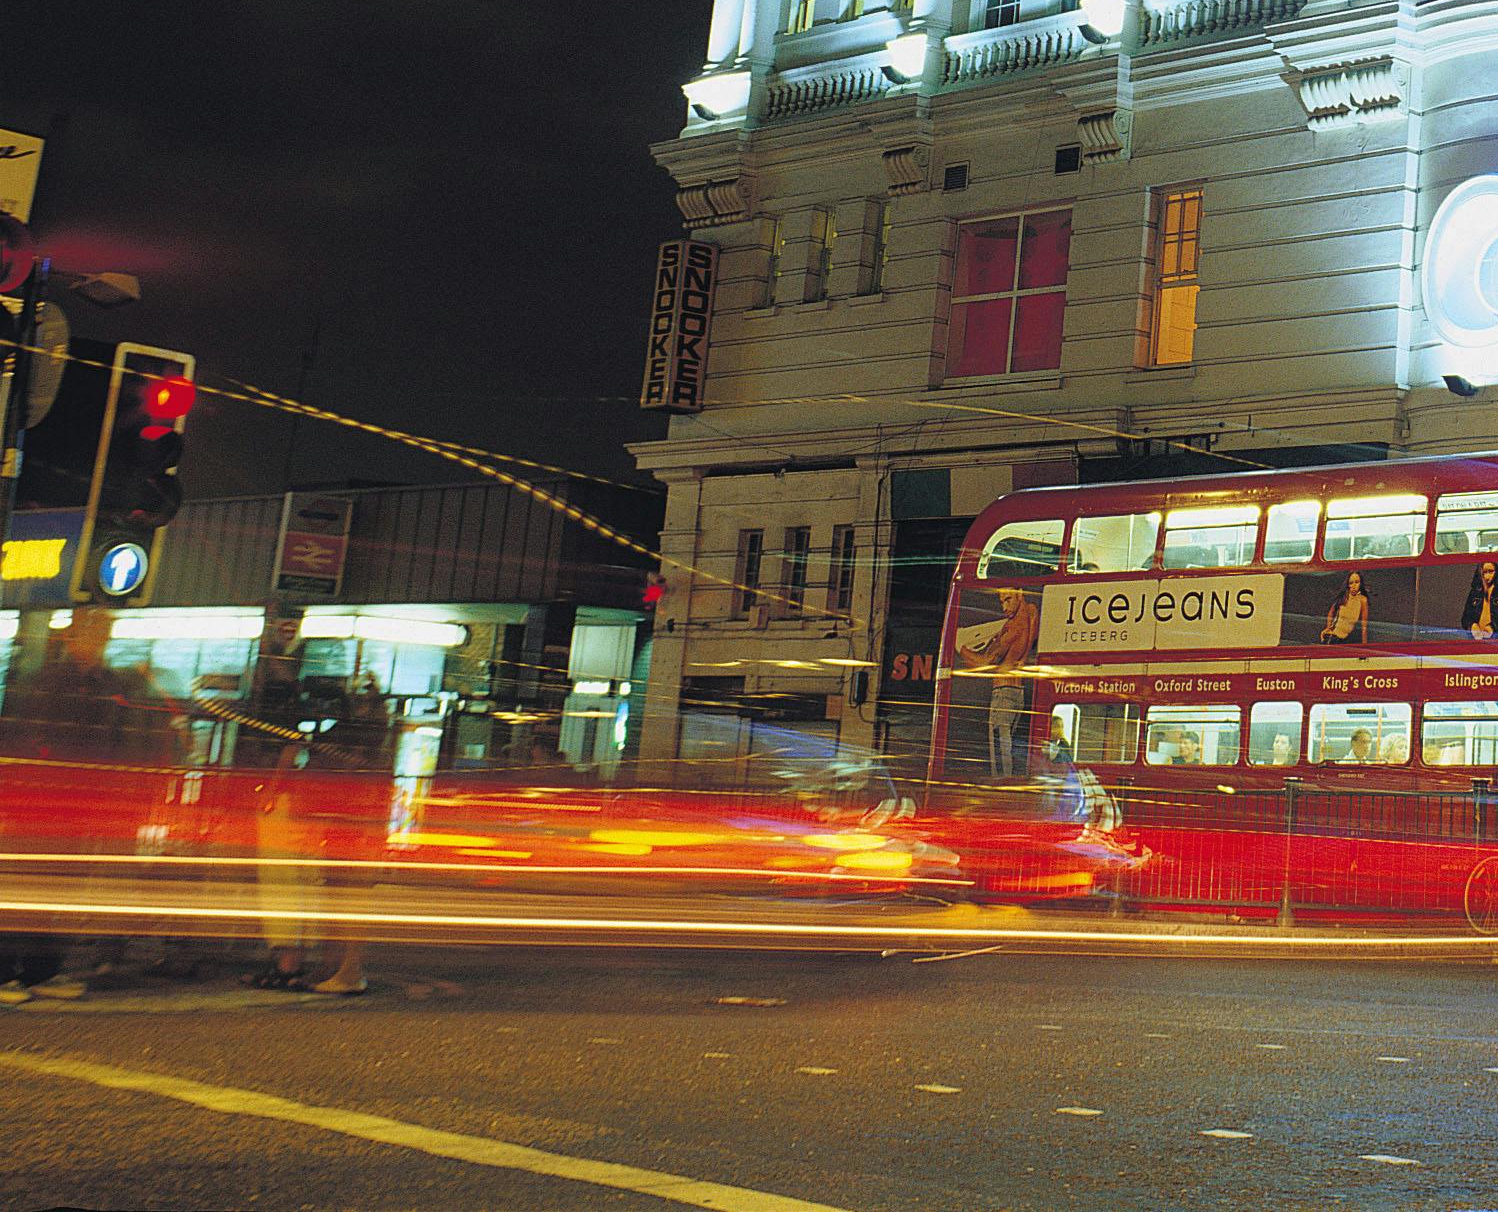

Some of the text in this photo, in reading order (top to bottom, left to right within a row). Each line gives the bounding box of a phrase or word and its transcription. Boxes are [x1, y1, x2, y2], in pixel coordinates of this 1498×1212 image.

[646, 244, 680, 405] SNOOKER
[672, 244, 713, 406] SNOOKER
[1064, 630, 1128, 643] ICEBERG
[1054, 680, 1136, 694] Victoria Station
[1154, 678, 1232, 692] Oxford Street
[1256, 677, 1296, 691] Euston
[1322, 675, 1399, 692] King's Cross
